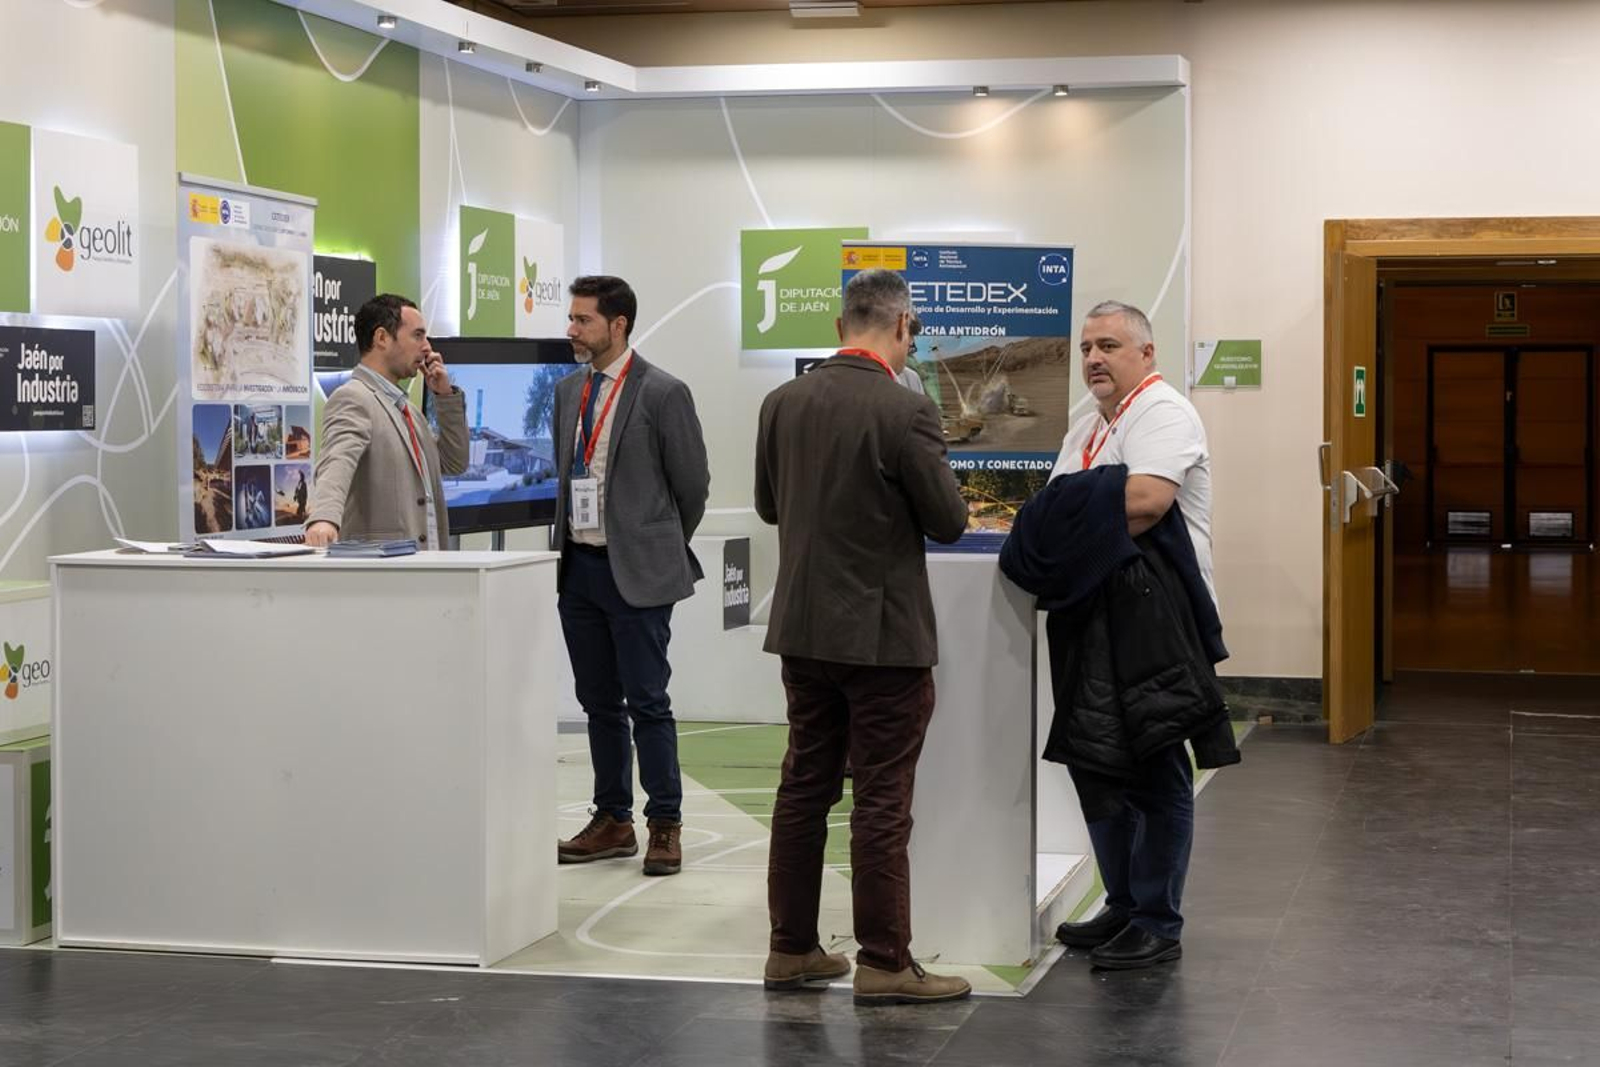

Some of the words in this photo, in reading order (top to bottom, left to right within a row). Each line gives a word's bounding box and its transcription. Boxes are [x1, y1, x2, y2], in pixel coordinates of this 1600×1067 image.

[0, 214, 19, 233] IÓN
[80, 221, 132, 260] geolit
[1042, 264, 1066, 274] INTA
[325, 279, 342, 305] por
[535, 278, 562, 303] geolit
[780, 286, 842, 298] DIPUTACIÓ
[909, 282, 1027, 303] ETEDEX
[780, 302, 797, 313] DE
[799, 301, 830, 313] JAÉN
[934, 304, 944, 313] de
[945, 305, 986, 313] Desarrollo
[987, 307, 992, 315] y
[993, 305, 1059, 315] Experimentación
[314, 306, 357, 344] ustria
[919, 326, 946, 336] UCHA
[949, 324, 1006, 336] ANTIDRÓN
[17, 342, 47, 370] Jaén
[49, 355, 64, 375] por
[17, 372, 78, 403] Industria
[949, 460, 975, 470] OMO
[978, 460, 986, 470] Y
[987, 460, 1053, 470] CONECTADO
[22, 659, 50, 688] geo
